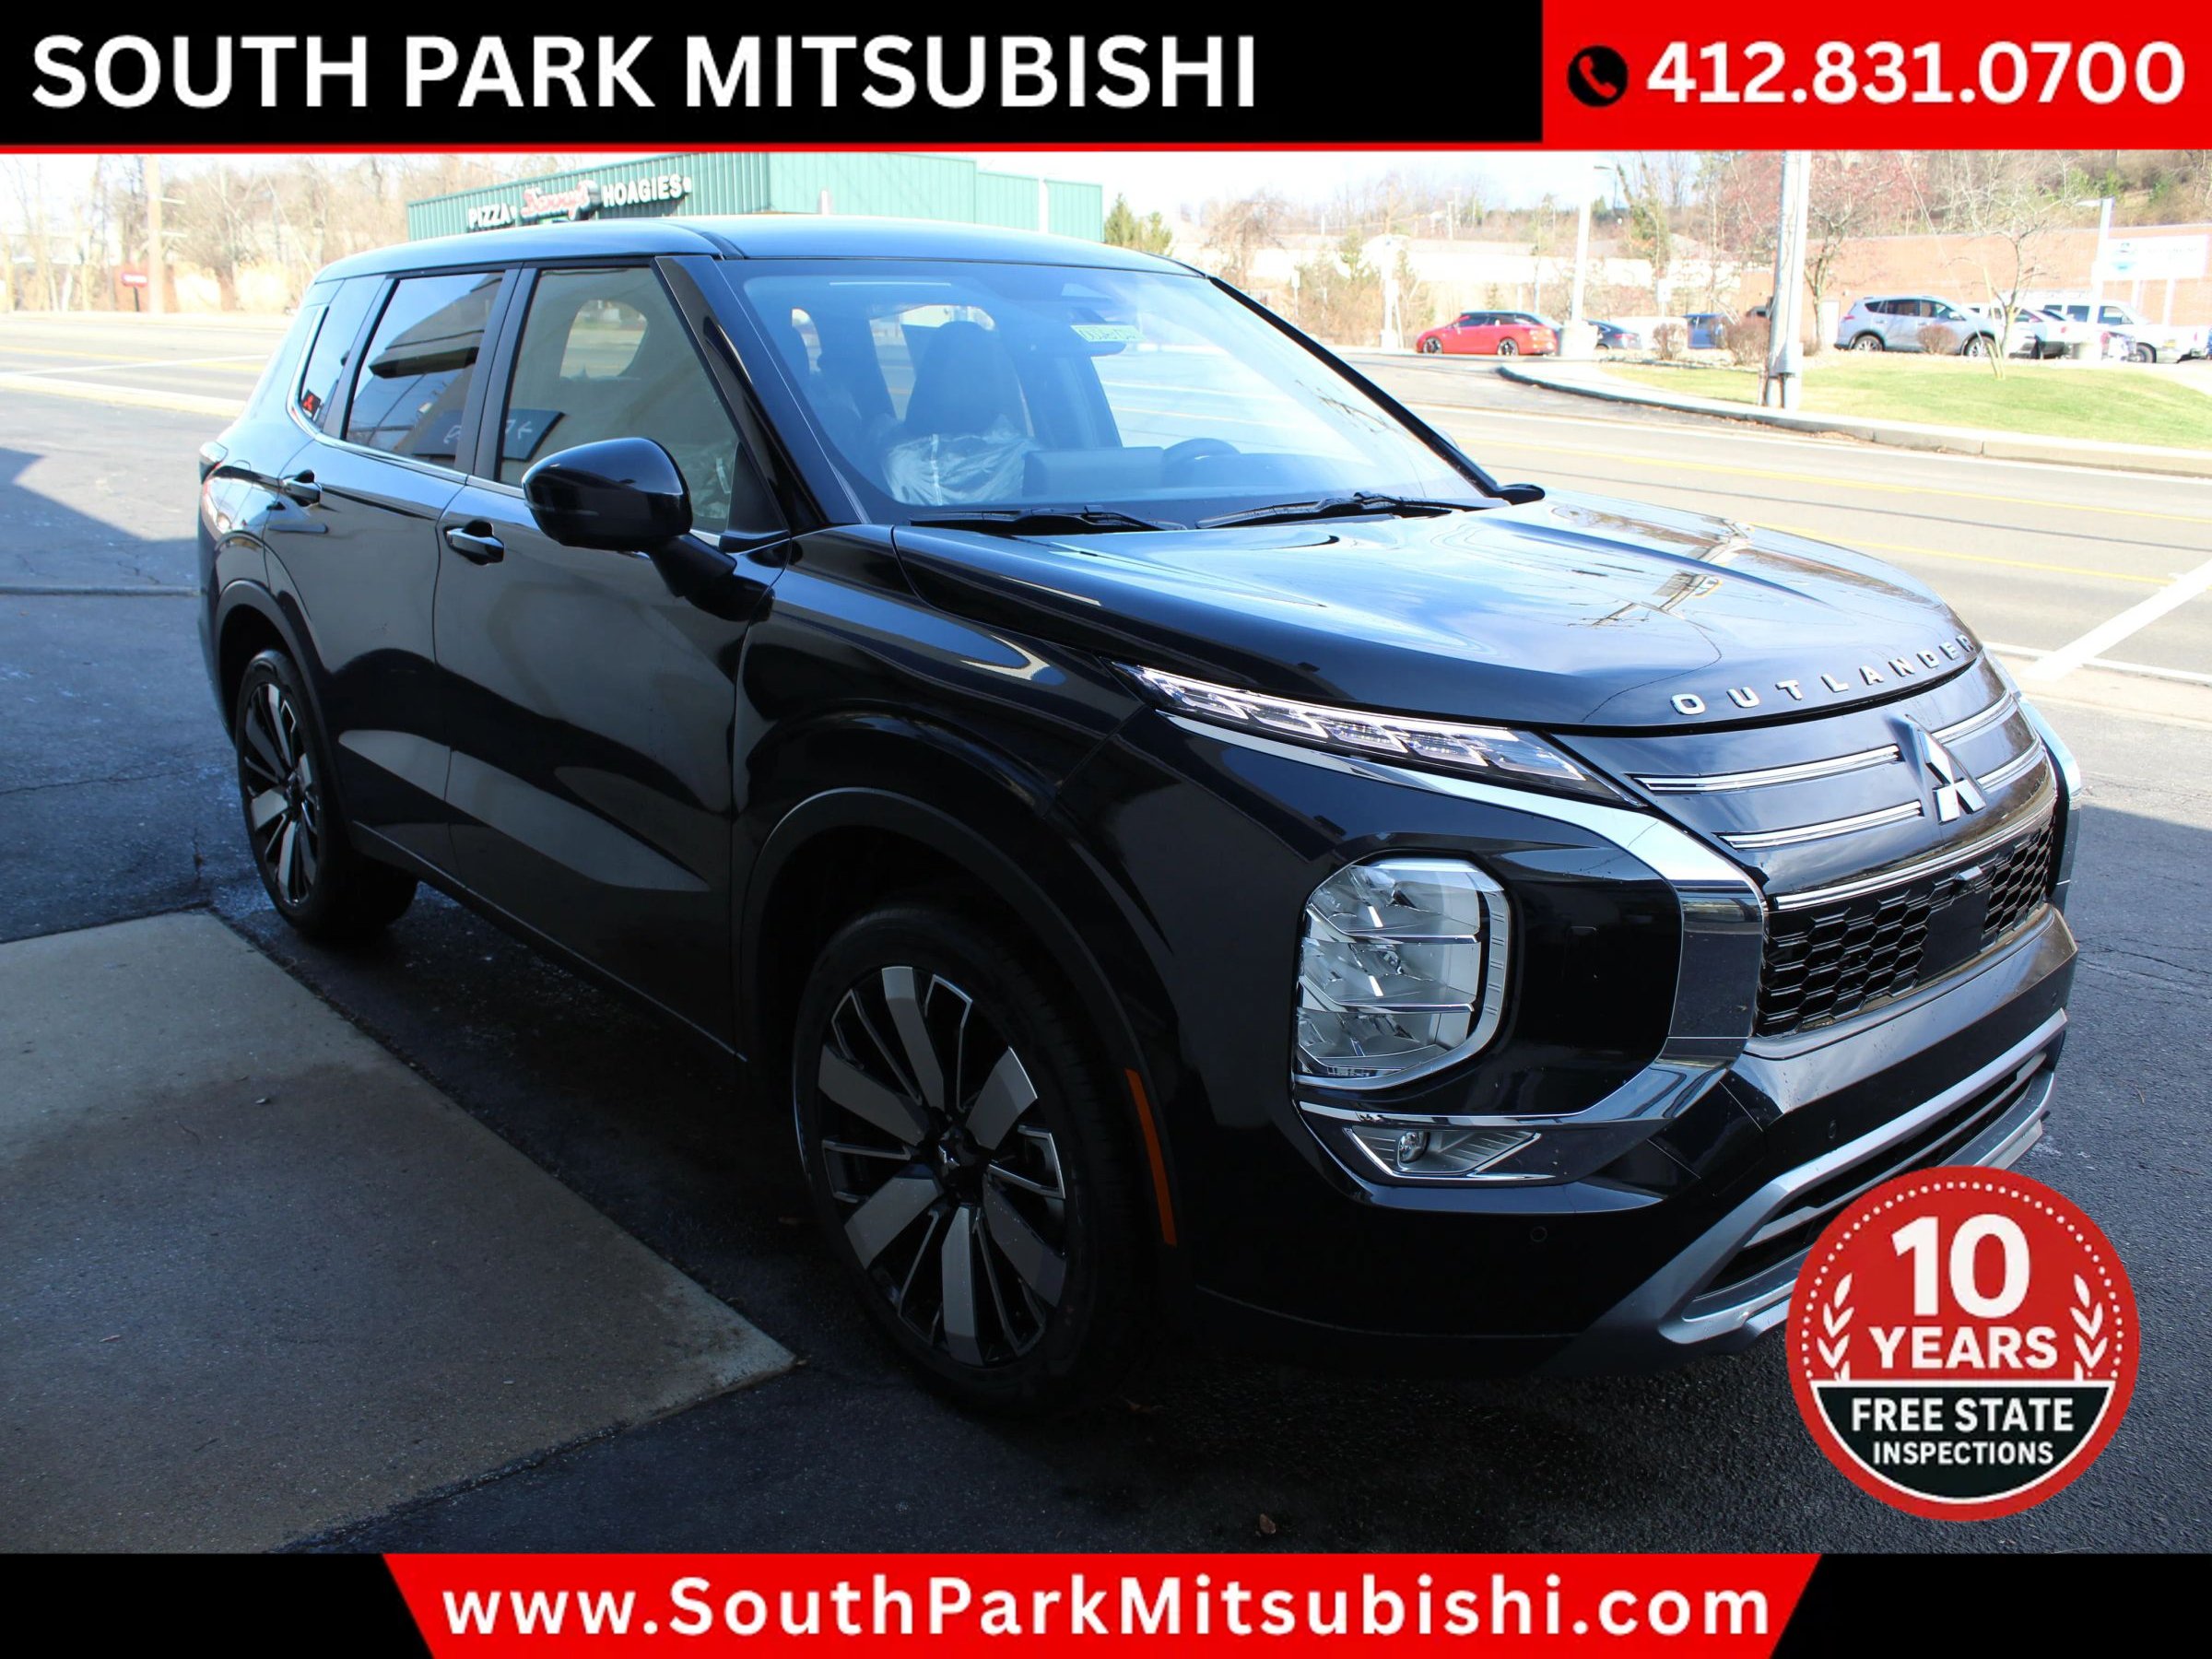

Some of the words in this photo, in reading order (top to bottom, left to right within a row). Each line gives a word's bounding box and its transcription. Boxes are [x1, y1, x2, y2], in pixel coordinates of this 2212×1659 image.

[467, 204, 511, 229] PIZZA
[602, 173, 684, 207] HOAGIES
[1670, 633, 1977, 716] OUTLANDER
